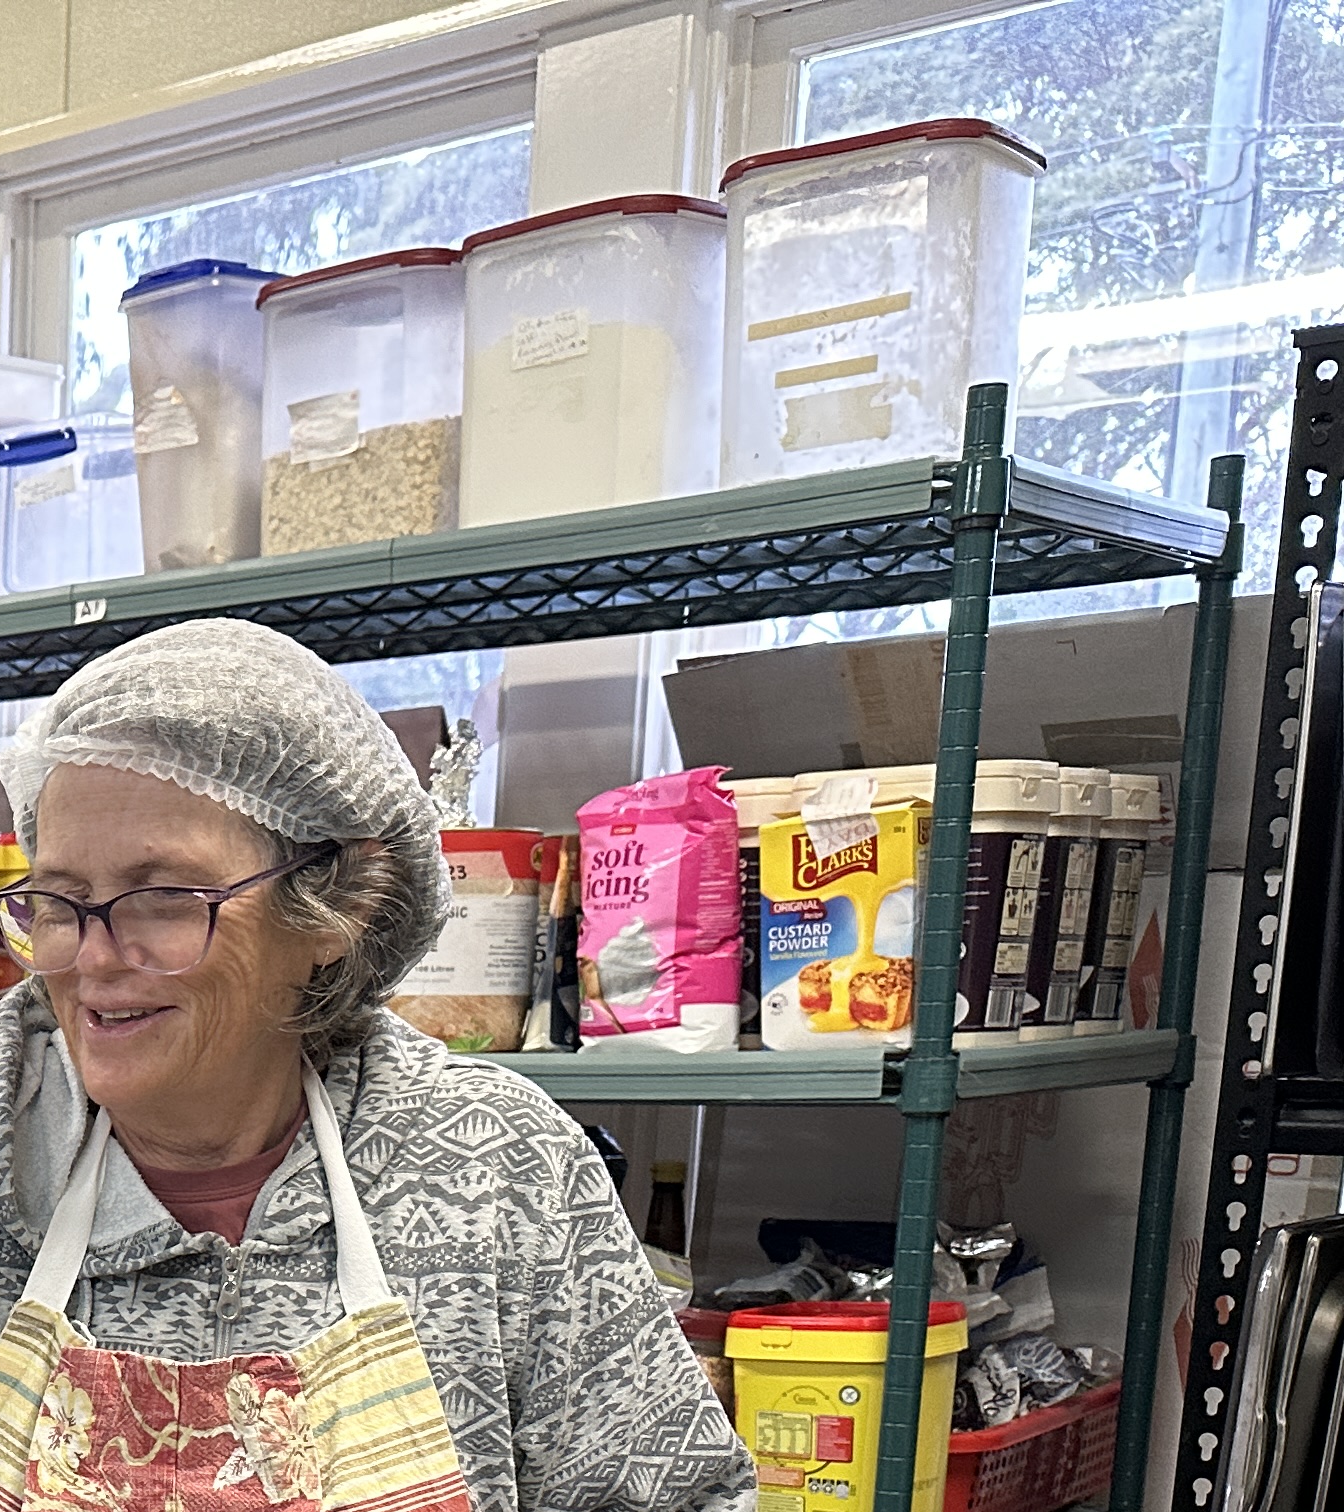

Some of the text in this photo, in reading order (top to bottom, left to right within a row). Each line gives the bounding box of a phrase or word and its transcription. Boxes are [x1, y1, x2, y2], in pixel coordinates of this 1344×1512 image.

[591, 840, 647, 872] soft
[797, 844, 874, 889] CLARKS
[585, 870, 650, 904] icing
[593, 902, 632, 911] MIXTURE
[773, 900, 820, 914] ORIGINAL
[768, 922, 832, 940] CUSTARD
[769, 936, 829, 953] POWDER
